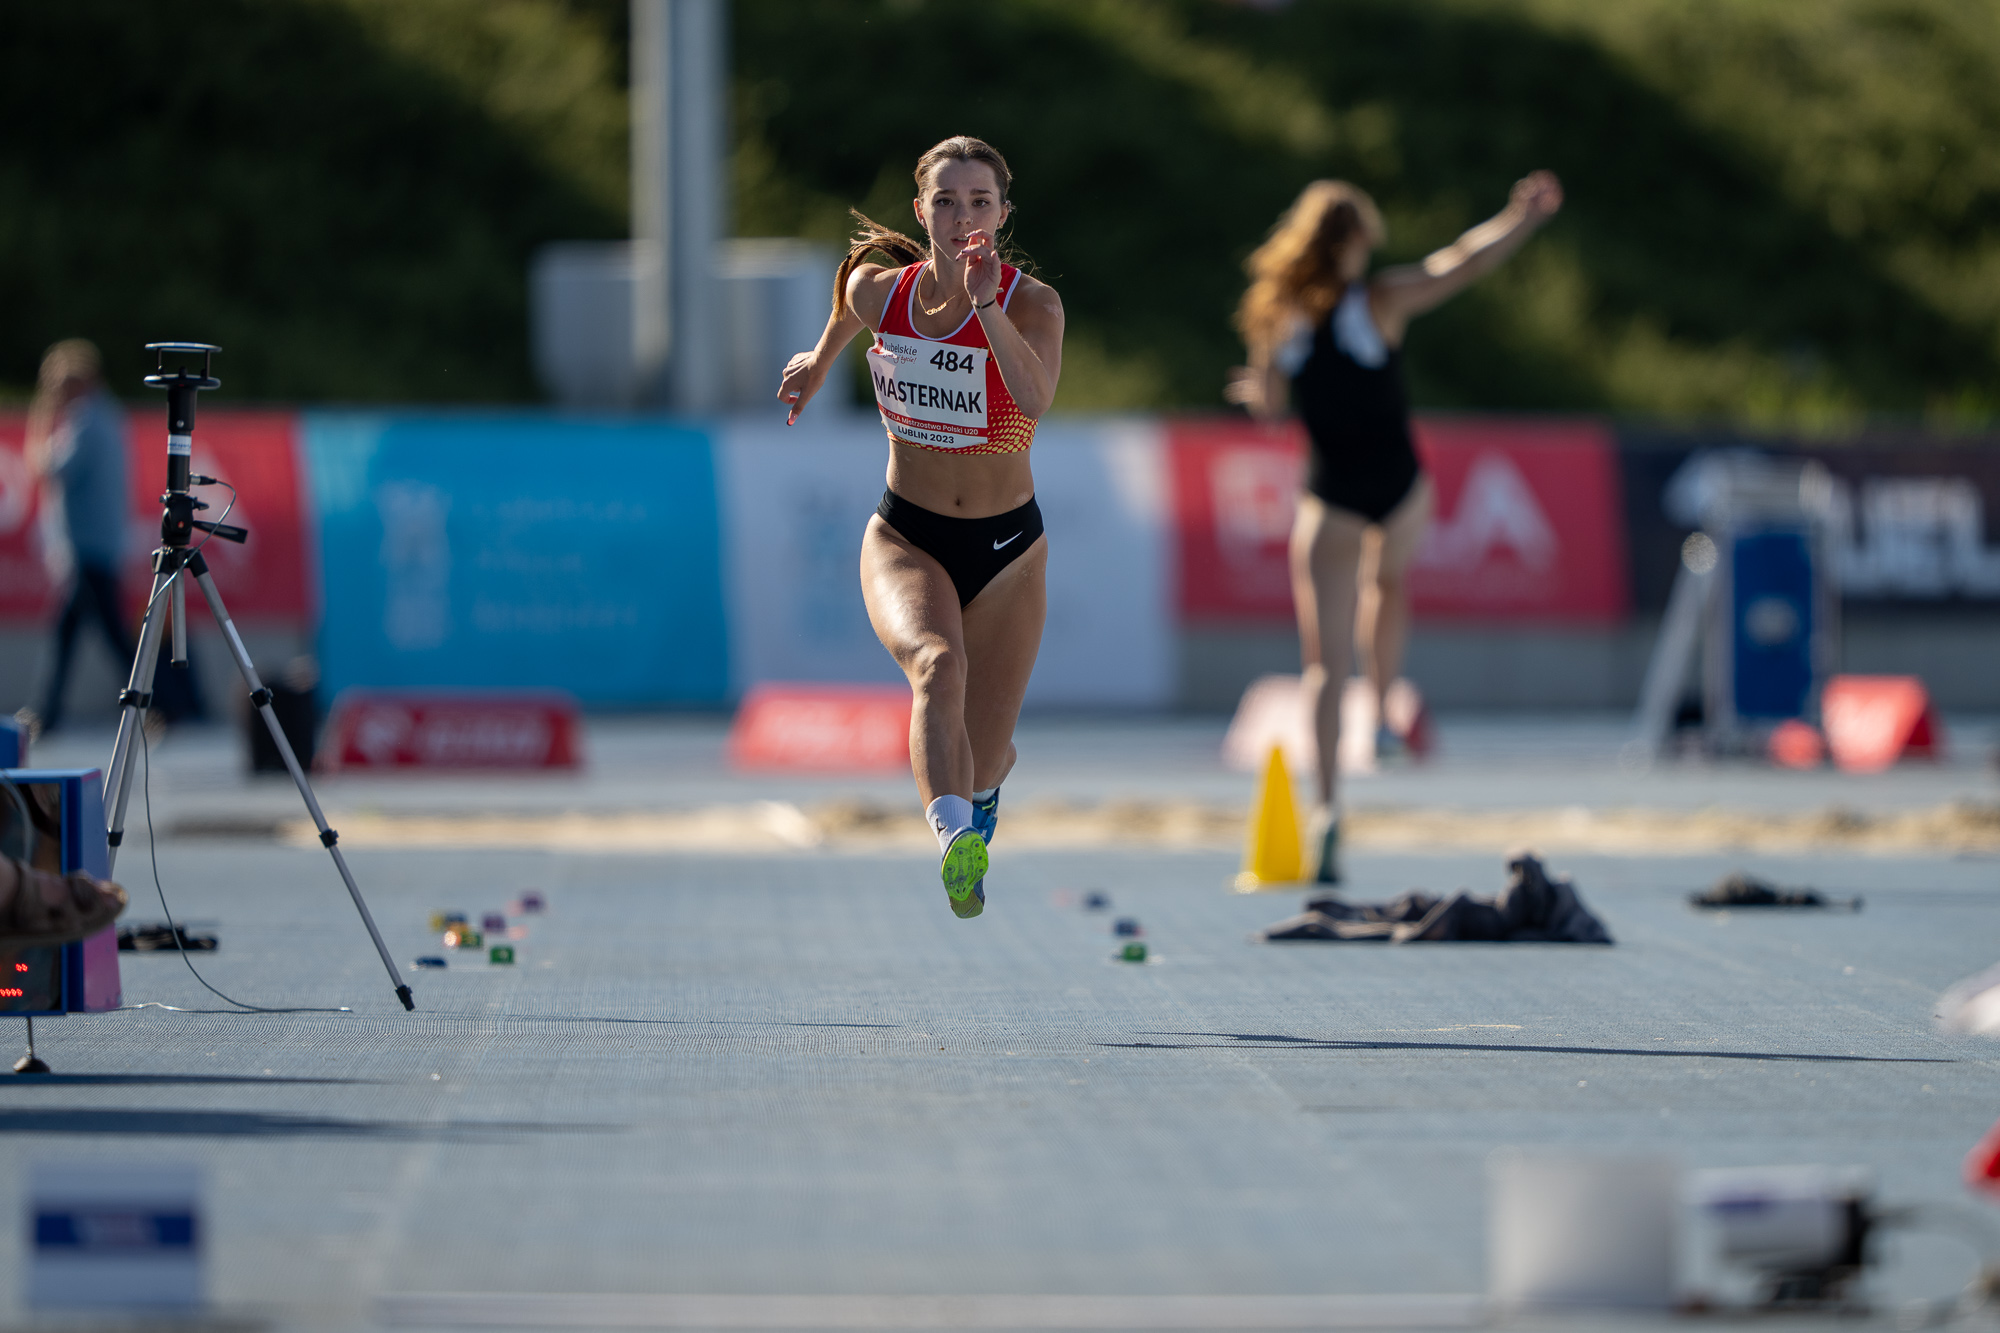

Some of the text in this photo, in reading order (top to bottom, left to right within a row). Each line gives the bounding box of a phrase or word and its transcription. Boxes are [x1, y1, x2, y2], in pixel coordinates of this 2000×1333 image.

[930, 349, 974, 374] 484
[873, 371, 982, 413] MASTERNAK
[897, 426, 954, 444] LUBLIN 2023
[901, 416, 941, 430] Mistrzostwa
[942, 425, 963, 434] Polski
[964, 428, 979, 436] U20
